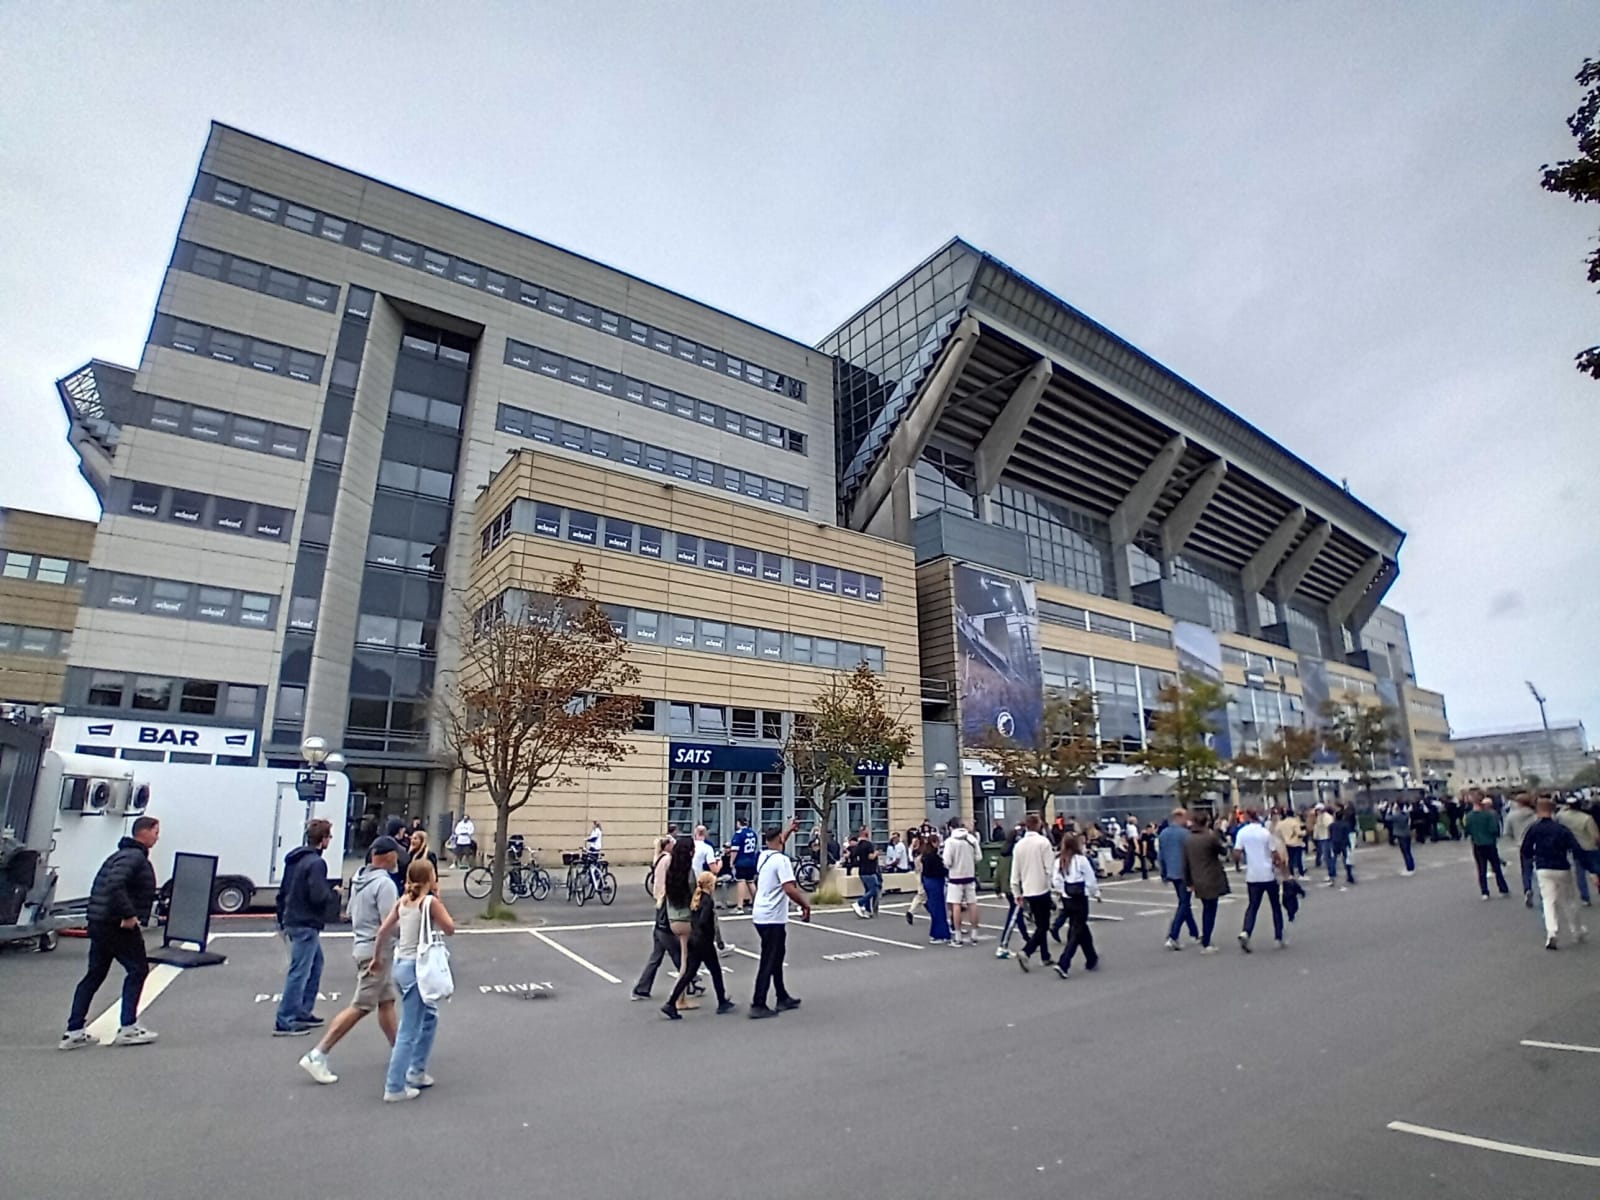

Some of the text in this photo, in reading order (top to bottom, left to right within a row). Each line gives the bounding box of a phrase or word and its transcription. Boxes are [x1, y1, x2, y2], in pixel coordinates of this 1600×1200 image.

[138, 726, 200, 747] BAR
[674, 748, 713, 764] SATS
[299, 773, 308, 782] P
[478, 981, 554, 994] PRIVAT
[253, 991, 342, 1003] PRAT
